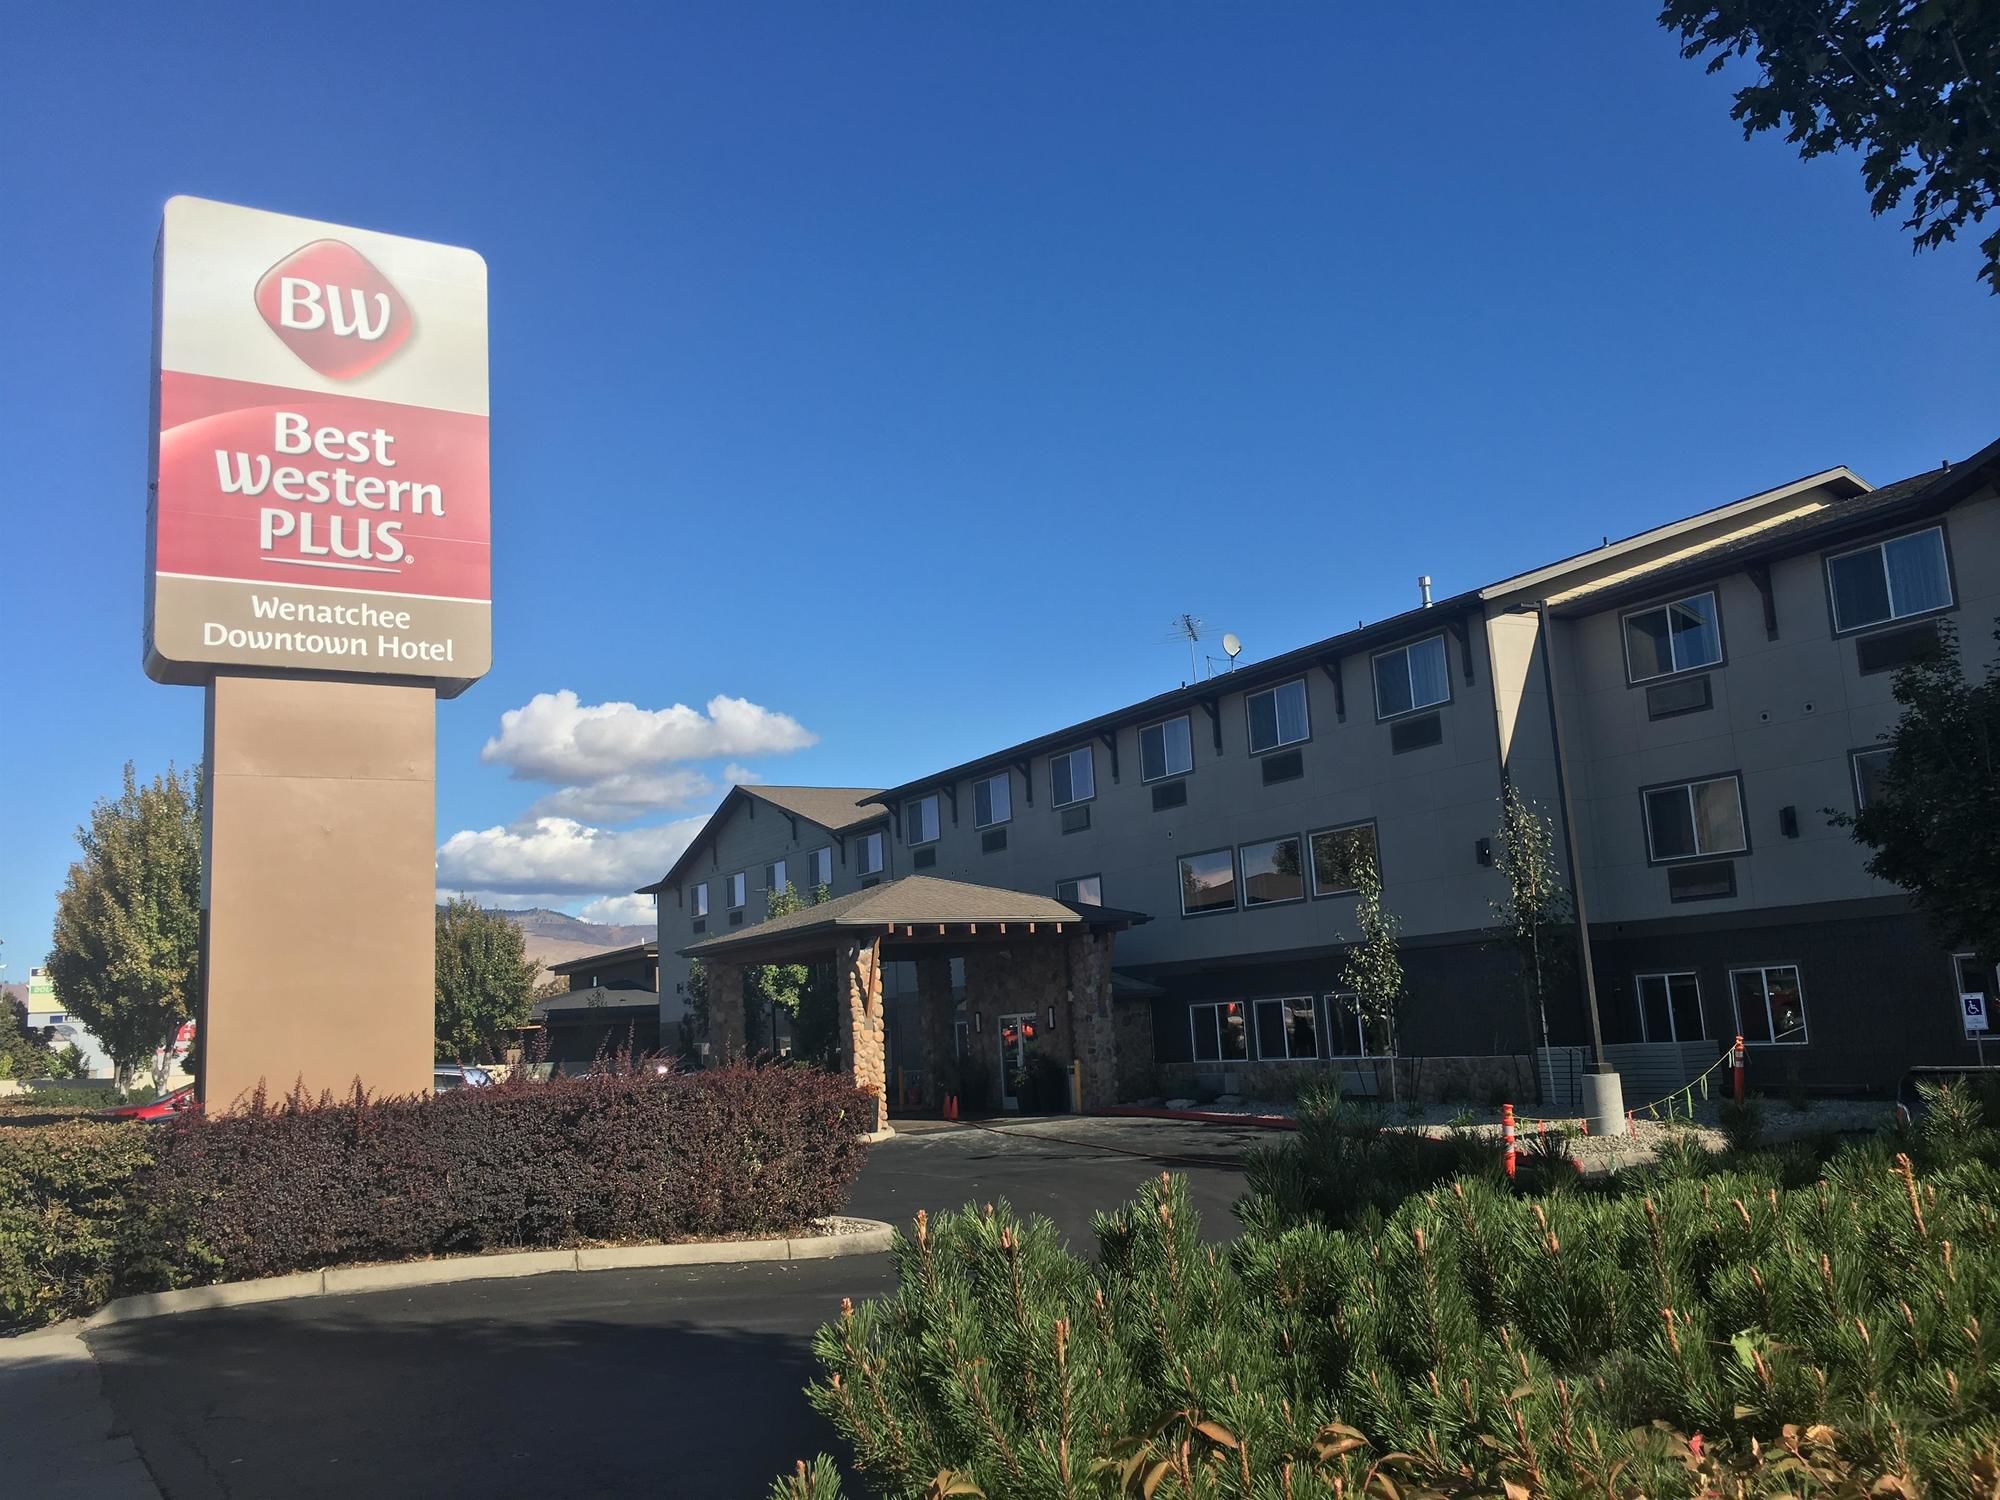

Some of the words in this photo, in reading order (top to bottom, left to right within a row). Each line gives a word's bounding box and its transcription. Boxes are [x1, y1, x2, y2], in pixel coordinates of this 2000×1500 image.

[281, 277, 390, 340] BW
[275, 412, 396, 467] Best
[215, 449, 445, 516] Western
[260, 508, 404, 562] PLUS
[252, 595, 411, 629] Wenatchee
[203, 622, 368, 656] Downtown
[378, 635, 454, 662] Hotel
